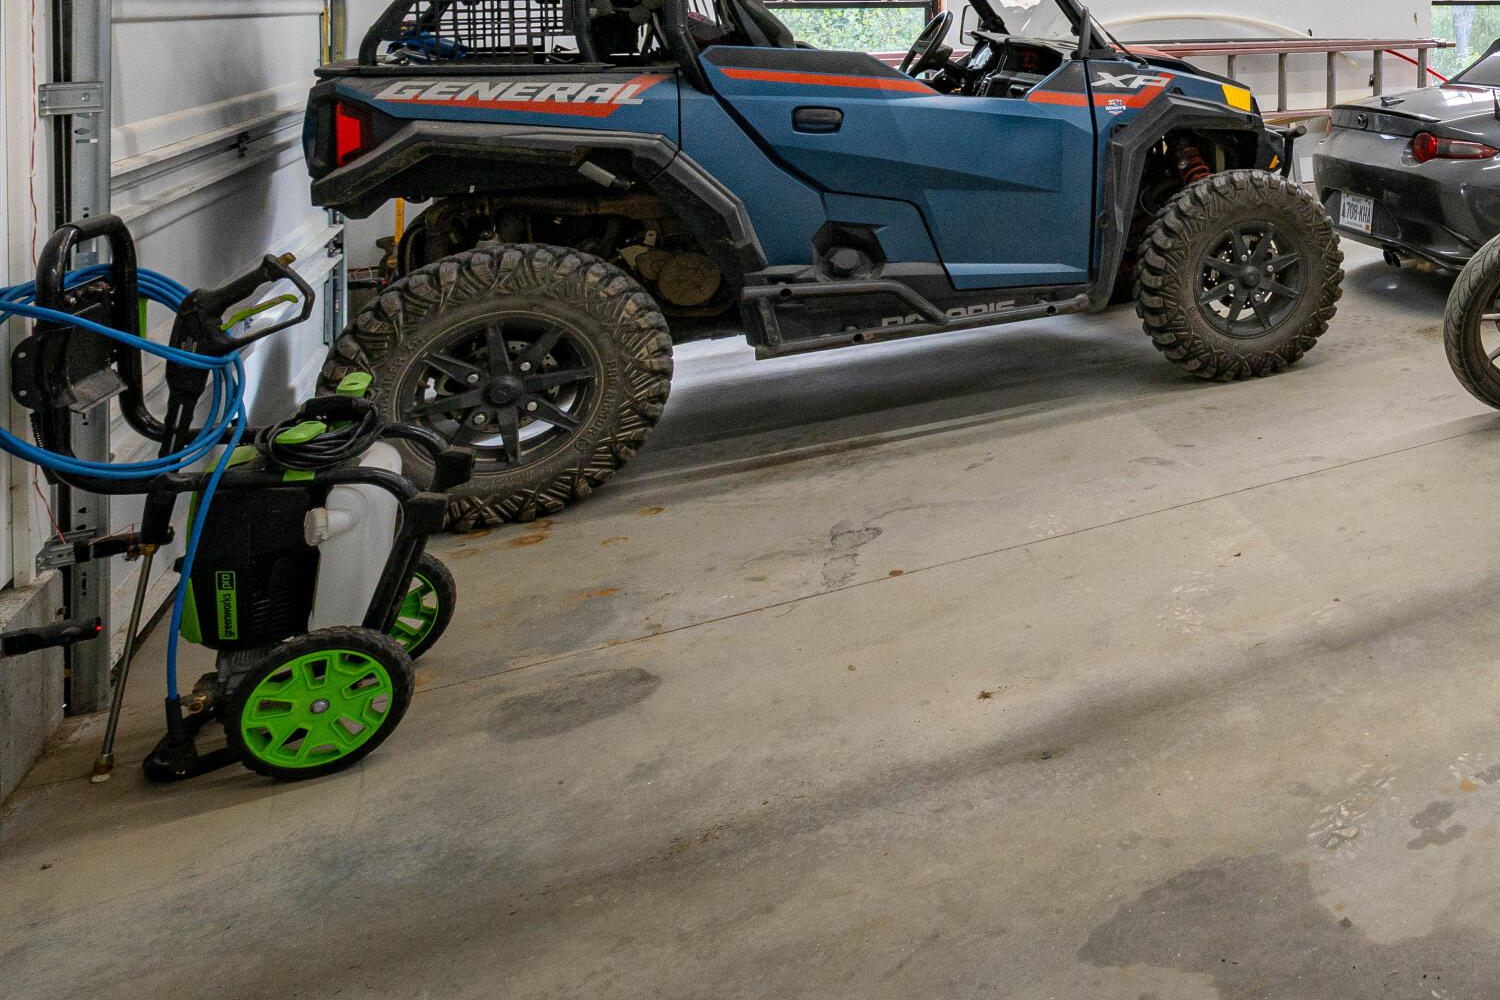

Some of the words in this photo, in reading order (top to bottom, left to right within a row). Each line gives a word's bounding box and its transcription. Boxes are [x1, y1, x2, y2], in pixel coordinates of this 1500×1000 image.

[1091, 72, 1171, 88] XP
[374, 81, 644, 105] GENERAL
[221, 573, 233, 590] pro
[223, 593, 235, 638] greenworks
